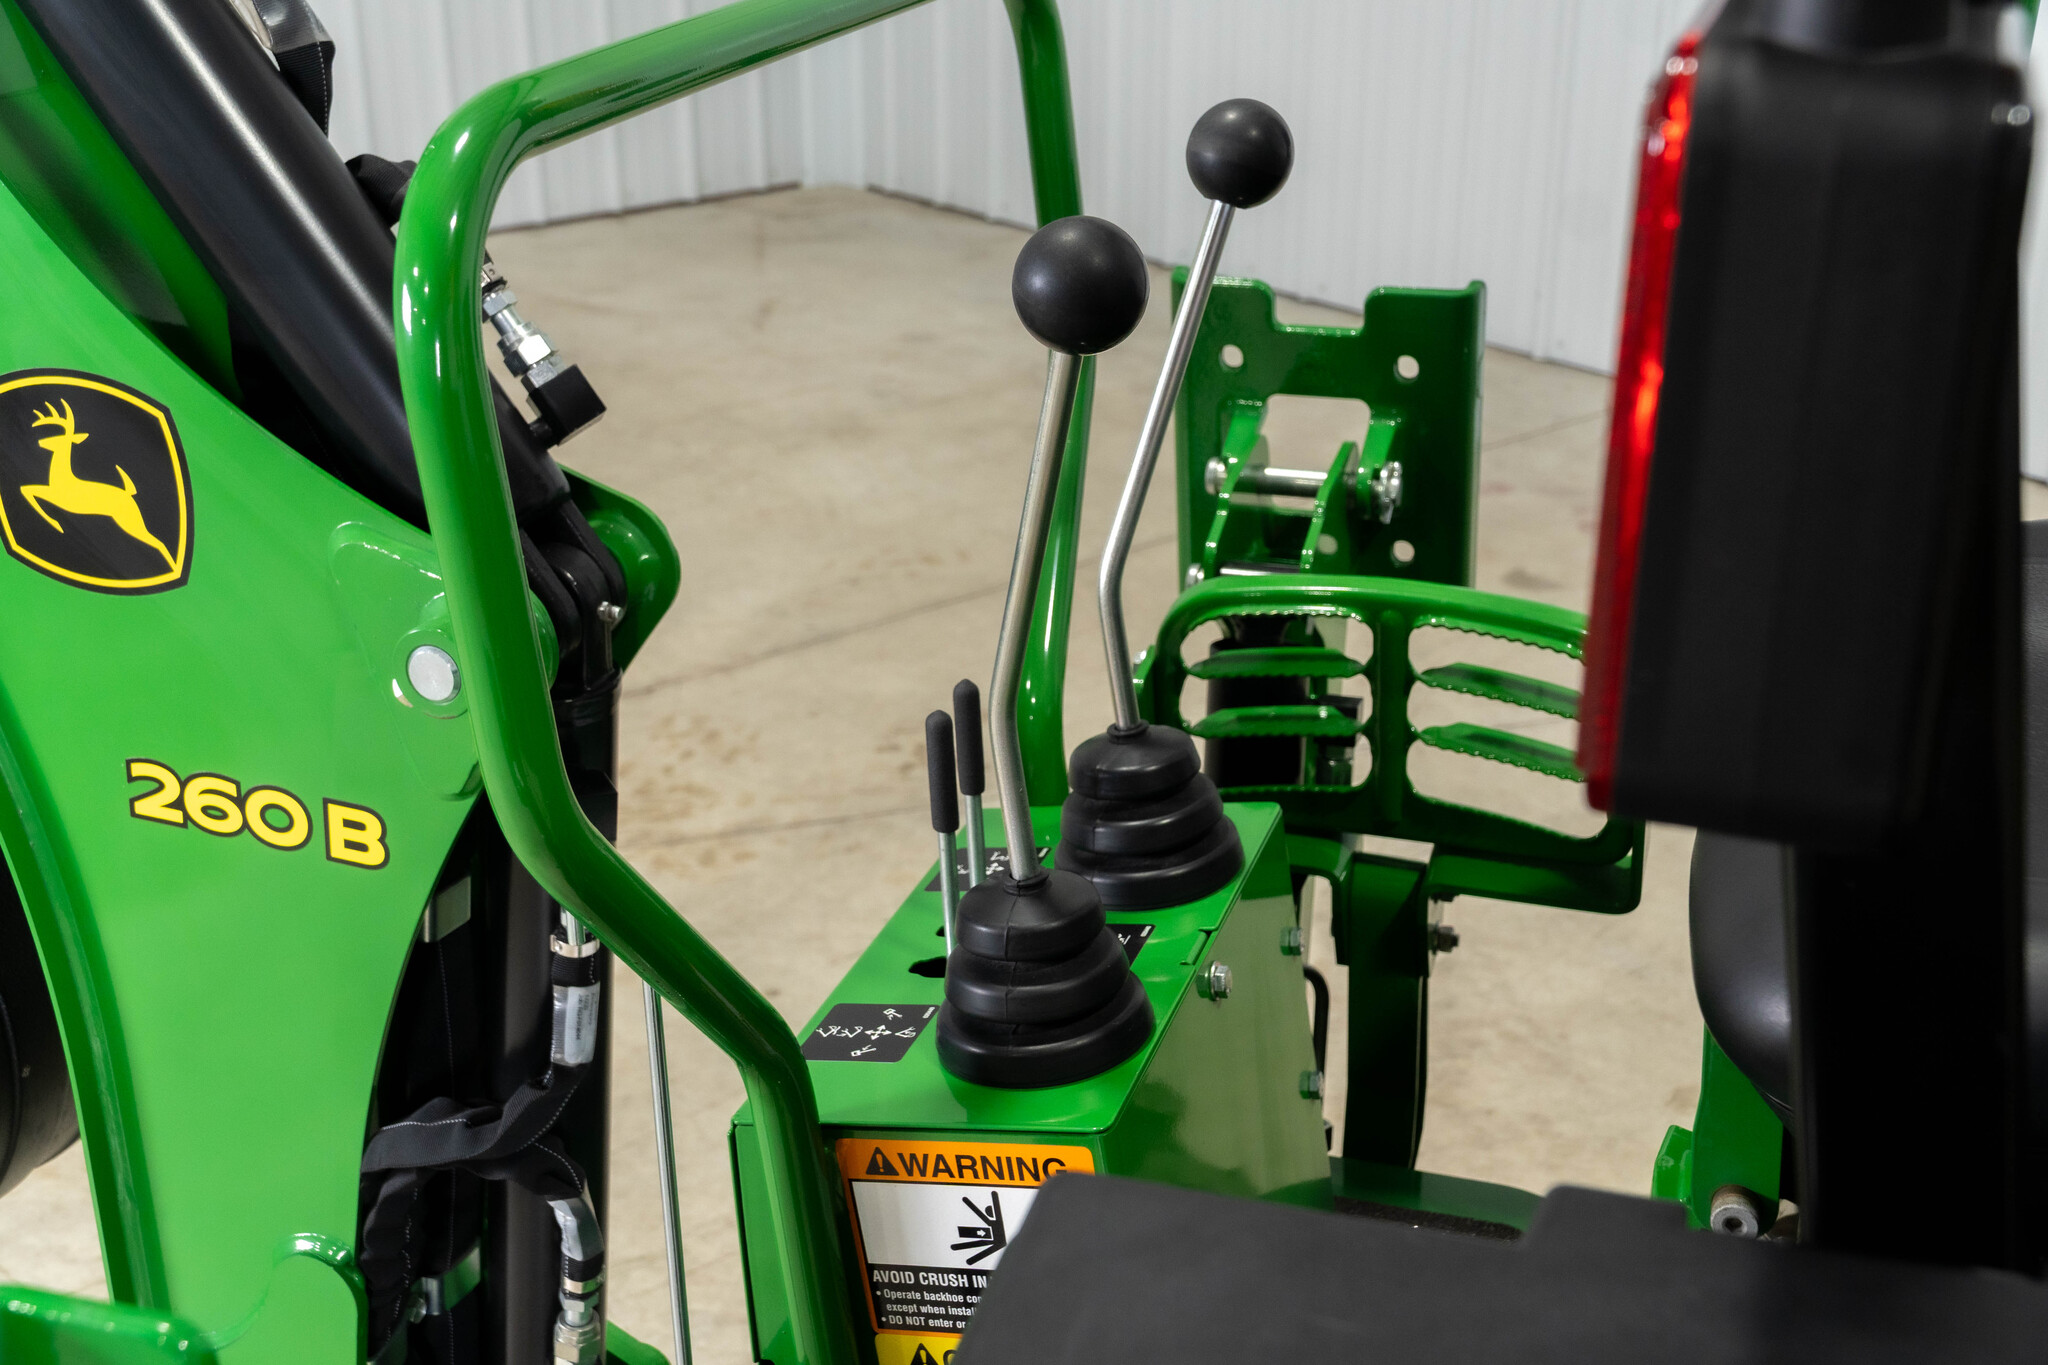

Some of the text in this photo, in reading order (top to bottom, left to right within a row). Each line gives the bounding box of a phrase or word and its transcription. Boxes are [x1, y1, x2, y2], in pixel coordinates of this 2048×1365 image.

[126, 758, 390, 870] 260 B
[897, 1152, 1067, 1182] WARNING
[873, 1270, 988, 1289] AVOID CRUSH IN
[883, 1289, 921, 1301] Operate
[923, 1291, 964, 1303] backhoe
[886, 1303, 976, 1316] except when instal
[888, 1315, 966, 1329] DO NOT enter or
